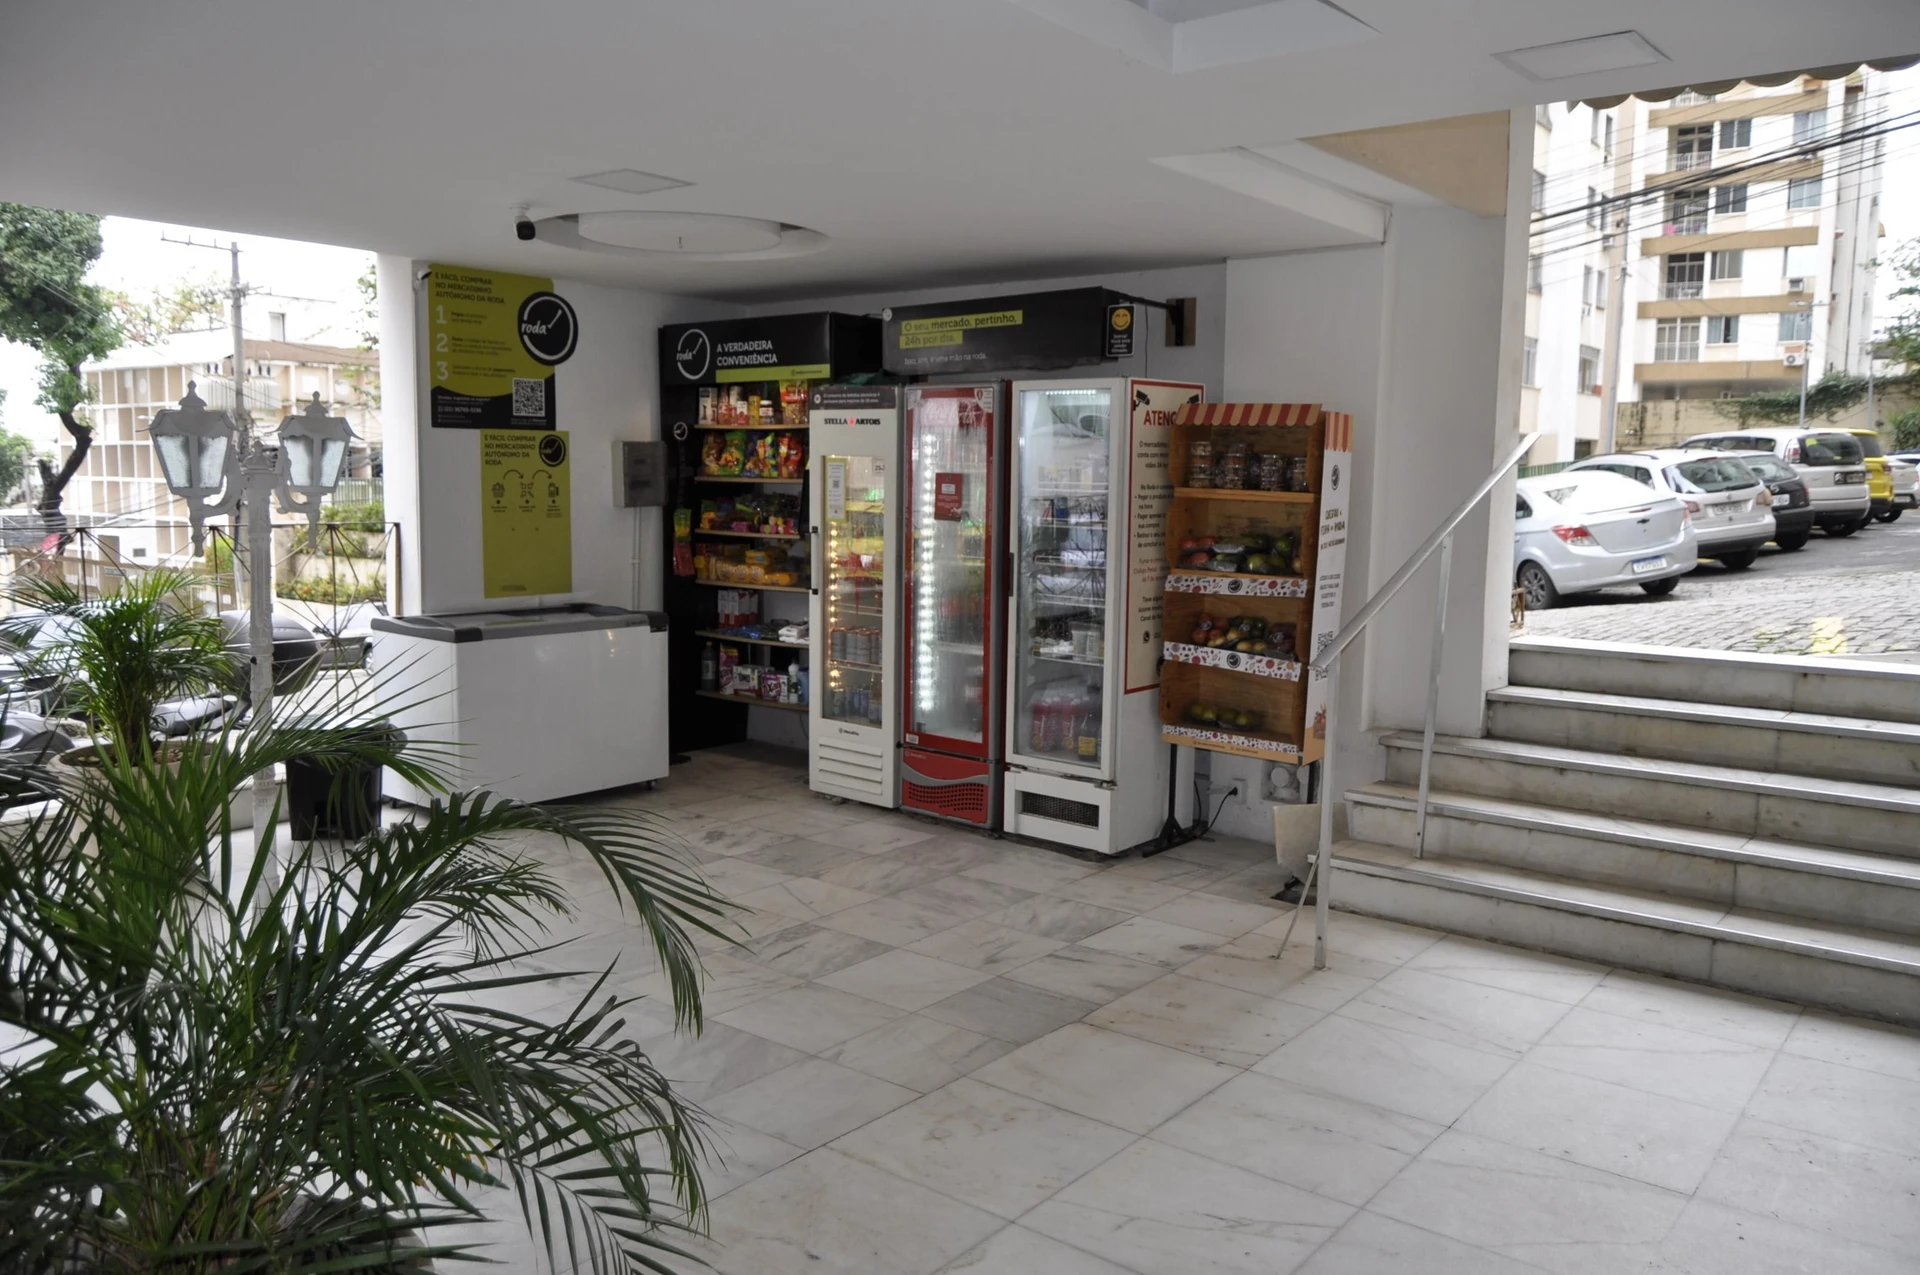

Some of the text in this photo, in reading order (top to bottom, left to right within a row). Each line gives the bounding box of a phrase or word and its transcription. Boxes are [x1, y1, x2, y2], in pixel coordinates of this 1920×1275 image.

[460, 276, 492, 284] COMPRAR
[448, 283, 492, 293] MERCADINHO
[436, 305, 447, 324] 1
[522, 320, 547, 335] roda
[904, 314, 1017, 332] O seu mercado, pertinho,
[436, 333, 448, 352] 2
[717, 340, 773, 352] A VERDADEIRA
[904, 336, 920, 346] 24h
[923, 335, 936, 345] por
[676, 349, 693, 361] roda
[717, 353, 778, 366] CONVENIÊNCIA
[437, 361, 449, 381] 3
